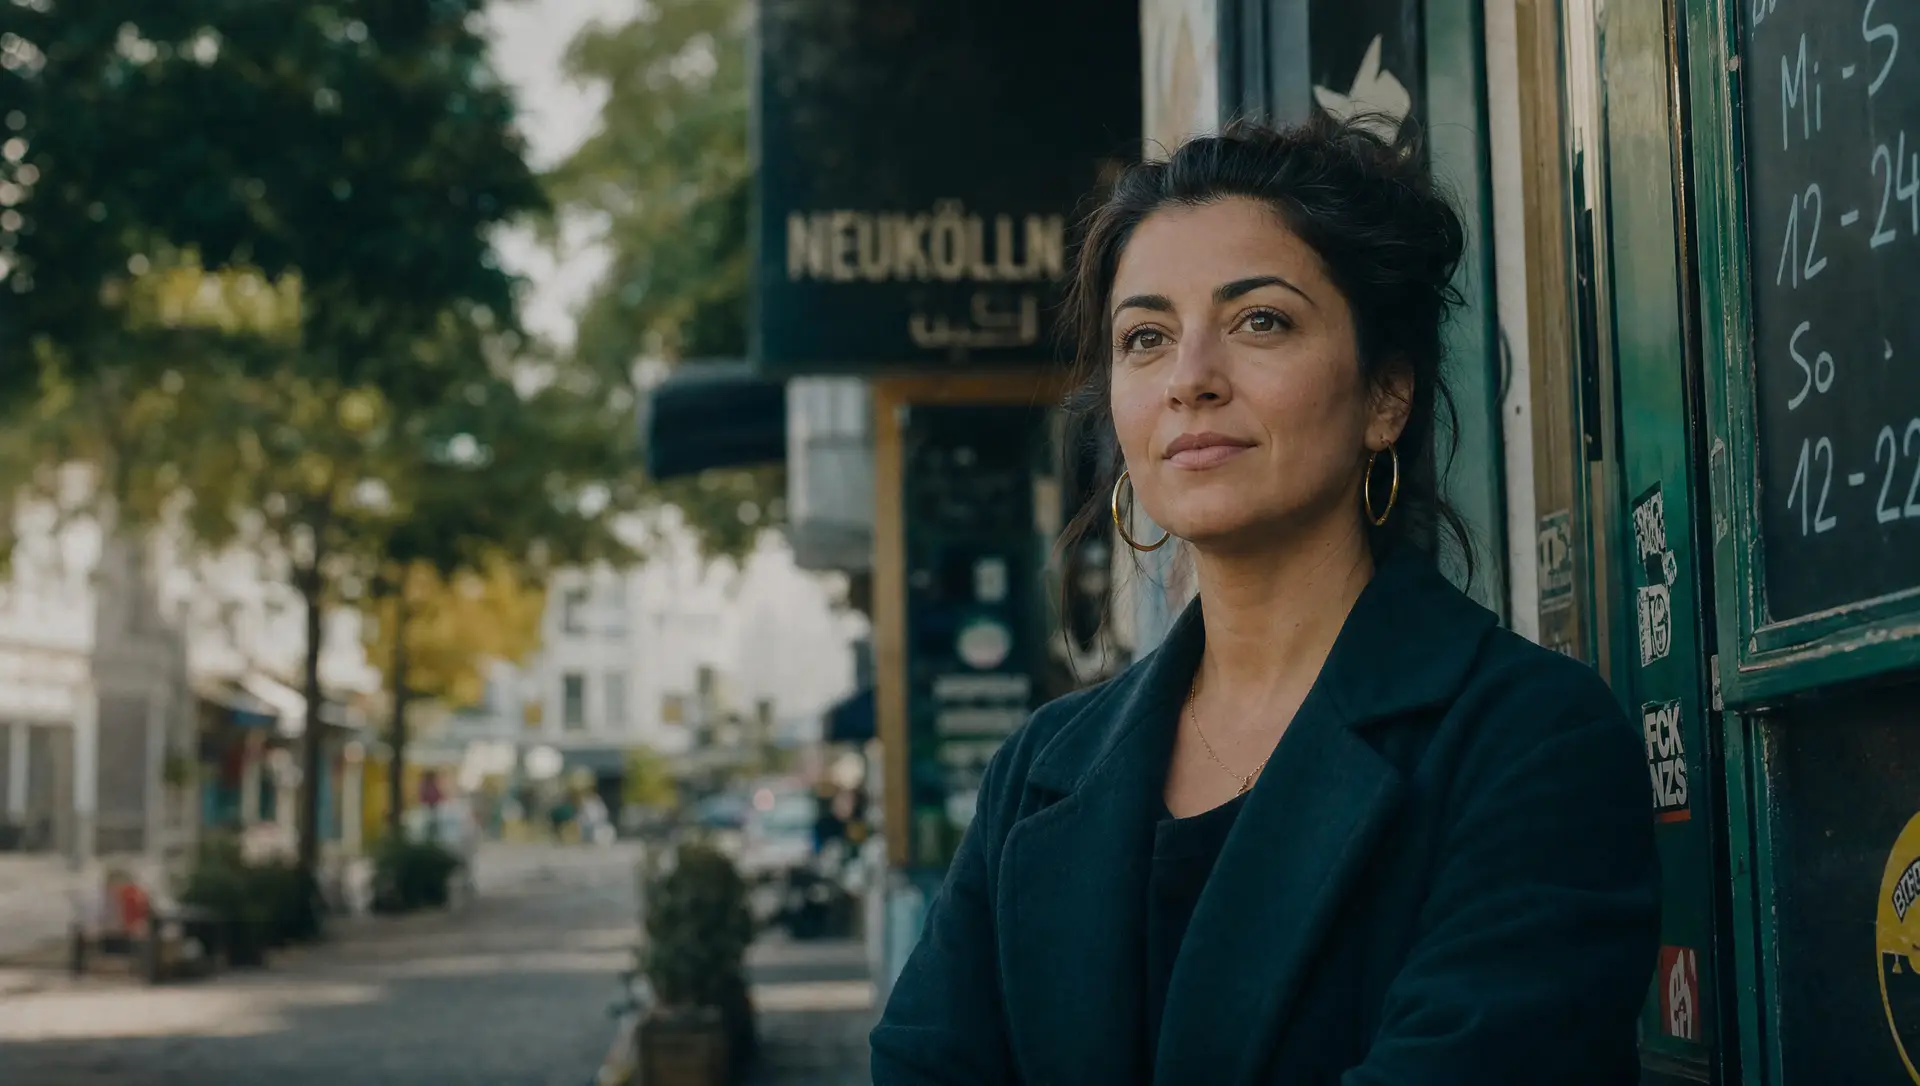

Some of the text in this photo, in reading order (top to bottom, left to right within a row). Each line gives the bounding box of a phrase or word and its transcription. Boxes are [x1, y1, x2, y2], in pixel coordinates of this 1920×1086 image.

[1782, 33, 1822, 151] Mi
[786, 199, 1064, 283] NEUKÖLLN
[1788, 320, 1835, 411] So
[1645, 706, 1684, 759] FCK
[1650, 758, 1687, 808] NZS
